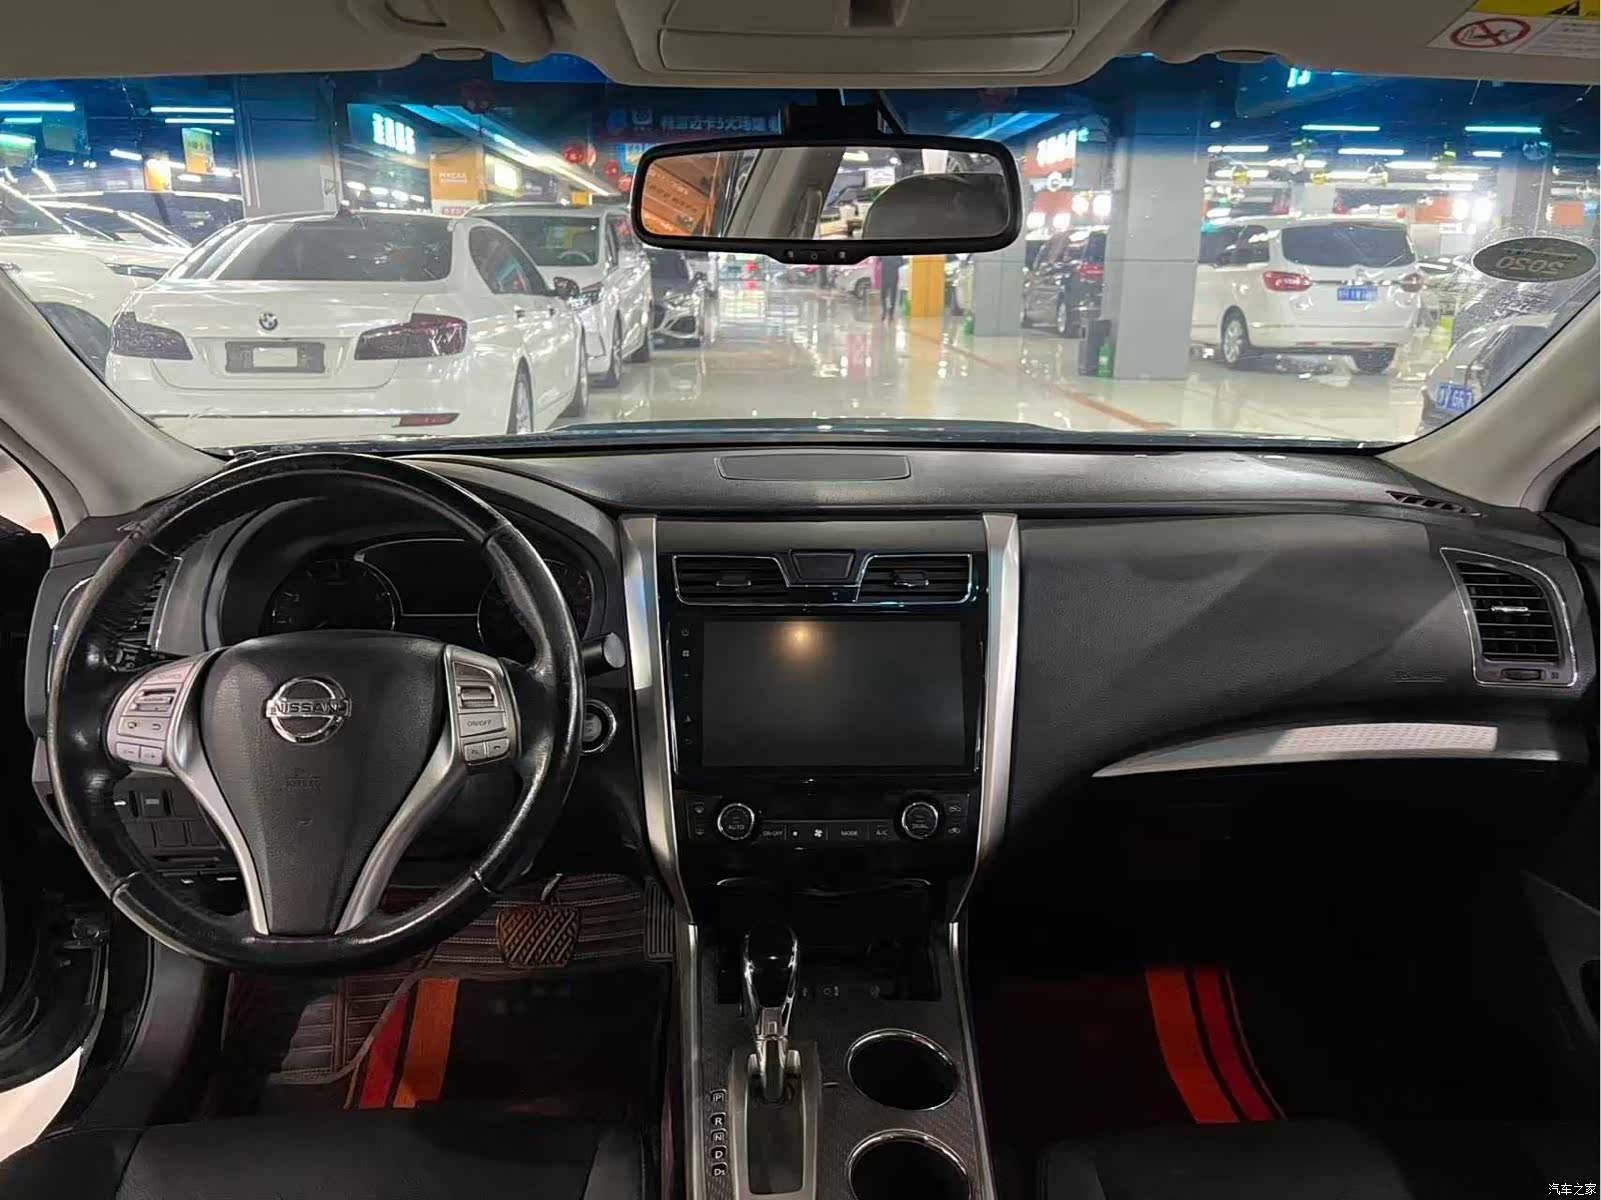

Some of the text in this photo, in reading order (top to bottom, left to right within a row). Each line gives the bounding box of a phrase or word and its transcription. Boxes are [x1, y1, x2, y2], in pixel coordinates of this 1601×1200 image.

[270, 702, 346, 714] NISSAN
[715, 1117, 722, 1125] R
[715, 1151, 723, 1159] D
